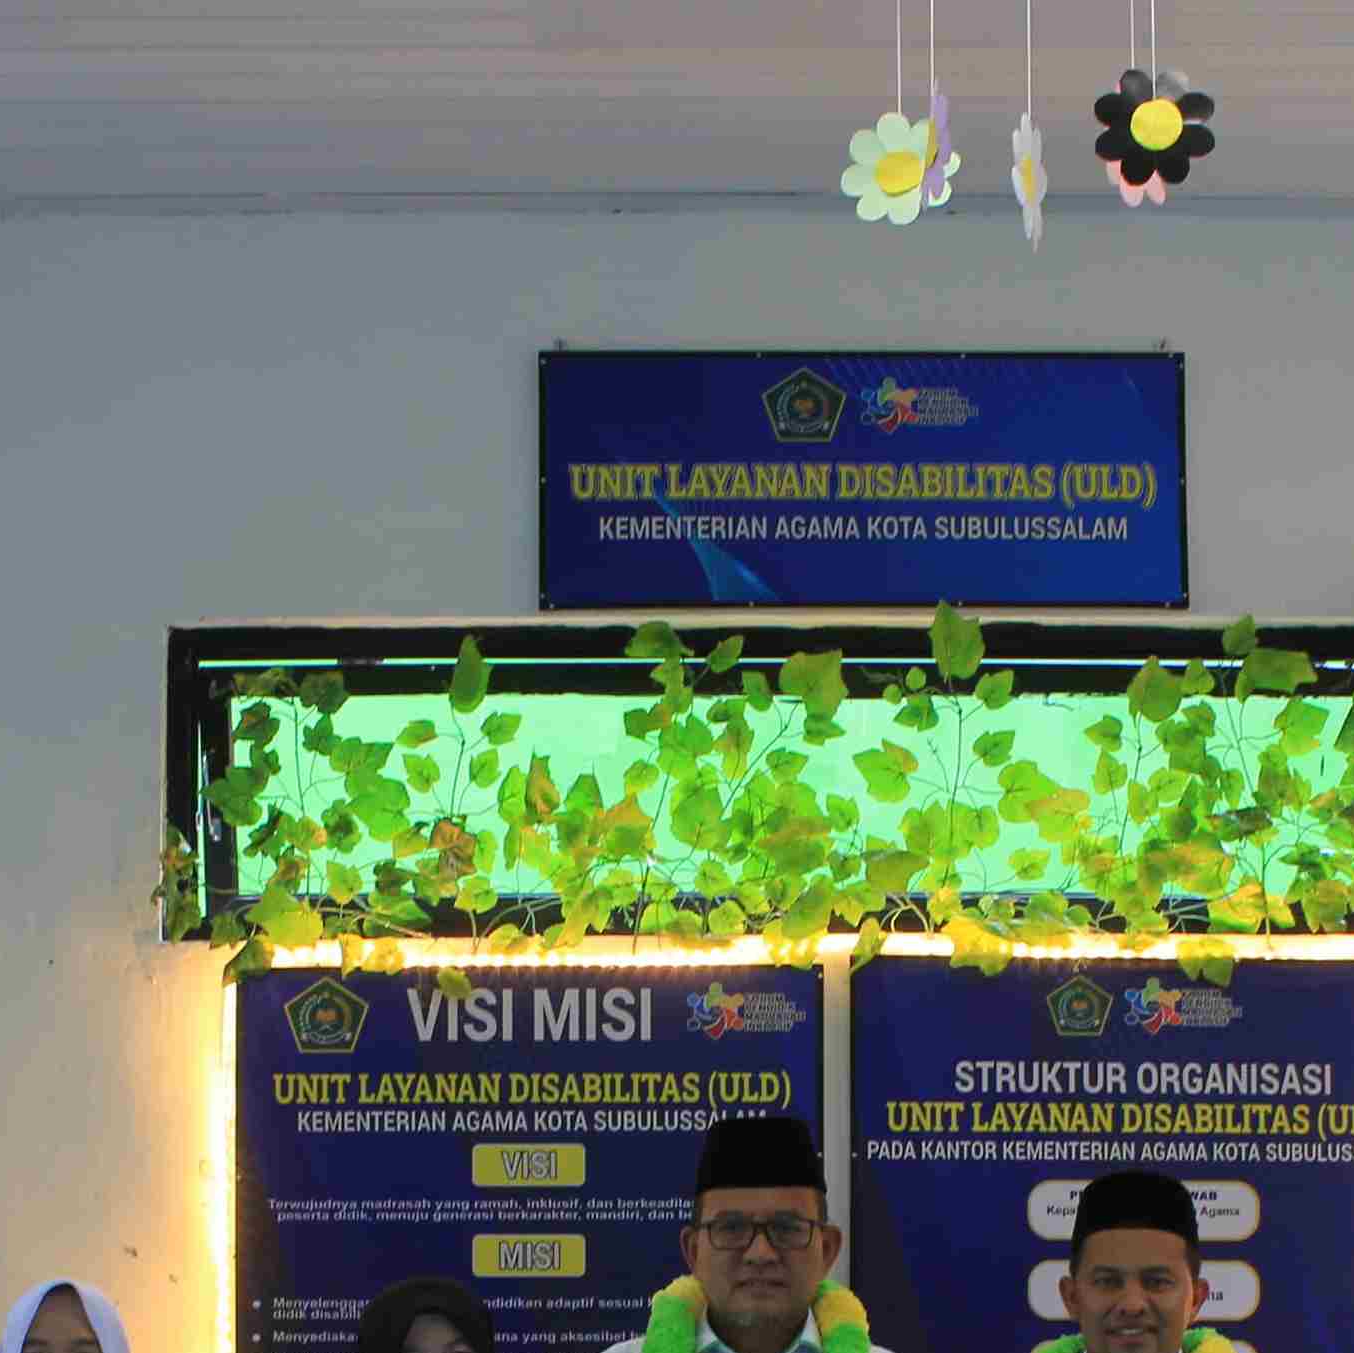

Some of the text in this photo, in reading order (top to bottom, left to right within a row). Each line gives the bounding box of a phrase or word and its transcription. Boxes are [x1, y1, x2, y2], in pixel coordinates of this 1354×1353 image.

[568, 463, 1158, 508] UNIT LAYANAN DISABILITAS (ULD)
[599, 515, 1129, 543] KEMENTERIAN AGAMA KOTA SUBULUSSALAM
[406, 988, 652, 1042] VISI MISI
[272, 1070, 793, 1110] UNIT LAYANAN DISABILITAS (ULD)
[954, 1060, 1333, 1097] STRUKTUR ORGANISASI
[297, 1110, 447, 1133] KEMENTERIAN
[452, 1110, 528, 1133] AGAMA
[534, 1110, 588, 1132] KOTA
[887, 1102, 964, 1133] UNIT
[972, 1102, 1115, 1134] LAYANAN
[1122, 1102, 1310, 1136] DISABILITAS
[867, 1140, 917, 1161] PADA
[921, 1140, 997, 1162] KANTOR
[1002, 1140, 1135, 1162] KEMENTERIAN
[1141, 1141, 1209, 1162] AGAMA
[1213, 1141, 1261, 1163] KOTA
[501, 1150, 558, 1181] VISI
[270, 1198, 358, 1212] Terwujudnya
[361, 1198, 431, 1210] madrasah
[435, 1200, 470, 1212] yang
[474, 1198, 522, 1211] ramah,
[527, 1198, 583, 1211] inklusif,
[587, 1198, 614, 1210] dan
[278, 1210, 329, 1222] peserta
[376, 1210, 429, 1222] menuju
[433, 1210, 494, 1222] generasi
[497, 1209, 581, 1221] berkarakter,
[586, 1209, 644, 1221] mandiri,
[648, 1209, 674, 1220] dan
[1199, 1206, 1241, 1218] Agama
[498, 1240, 562, 1271] MISI
[273, 1309, 306, 1320] didik
[546, 1297, 594, 1312] adaptif
[273, 1330, 359, 1344] Menyediaka
[522, 1332, 557, 1345] yang
[560, 1330, 627, 1342] aksesibel
